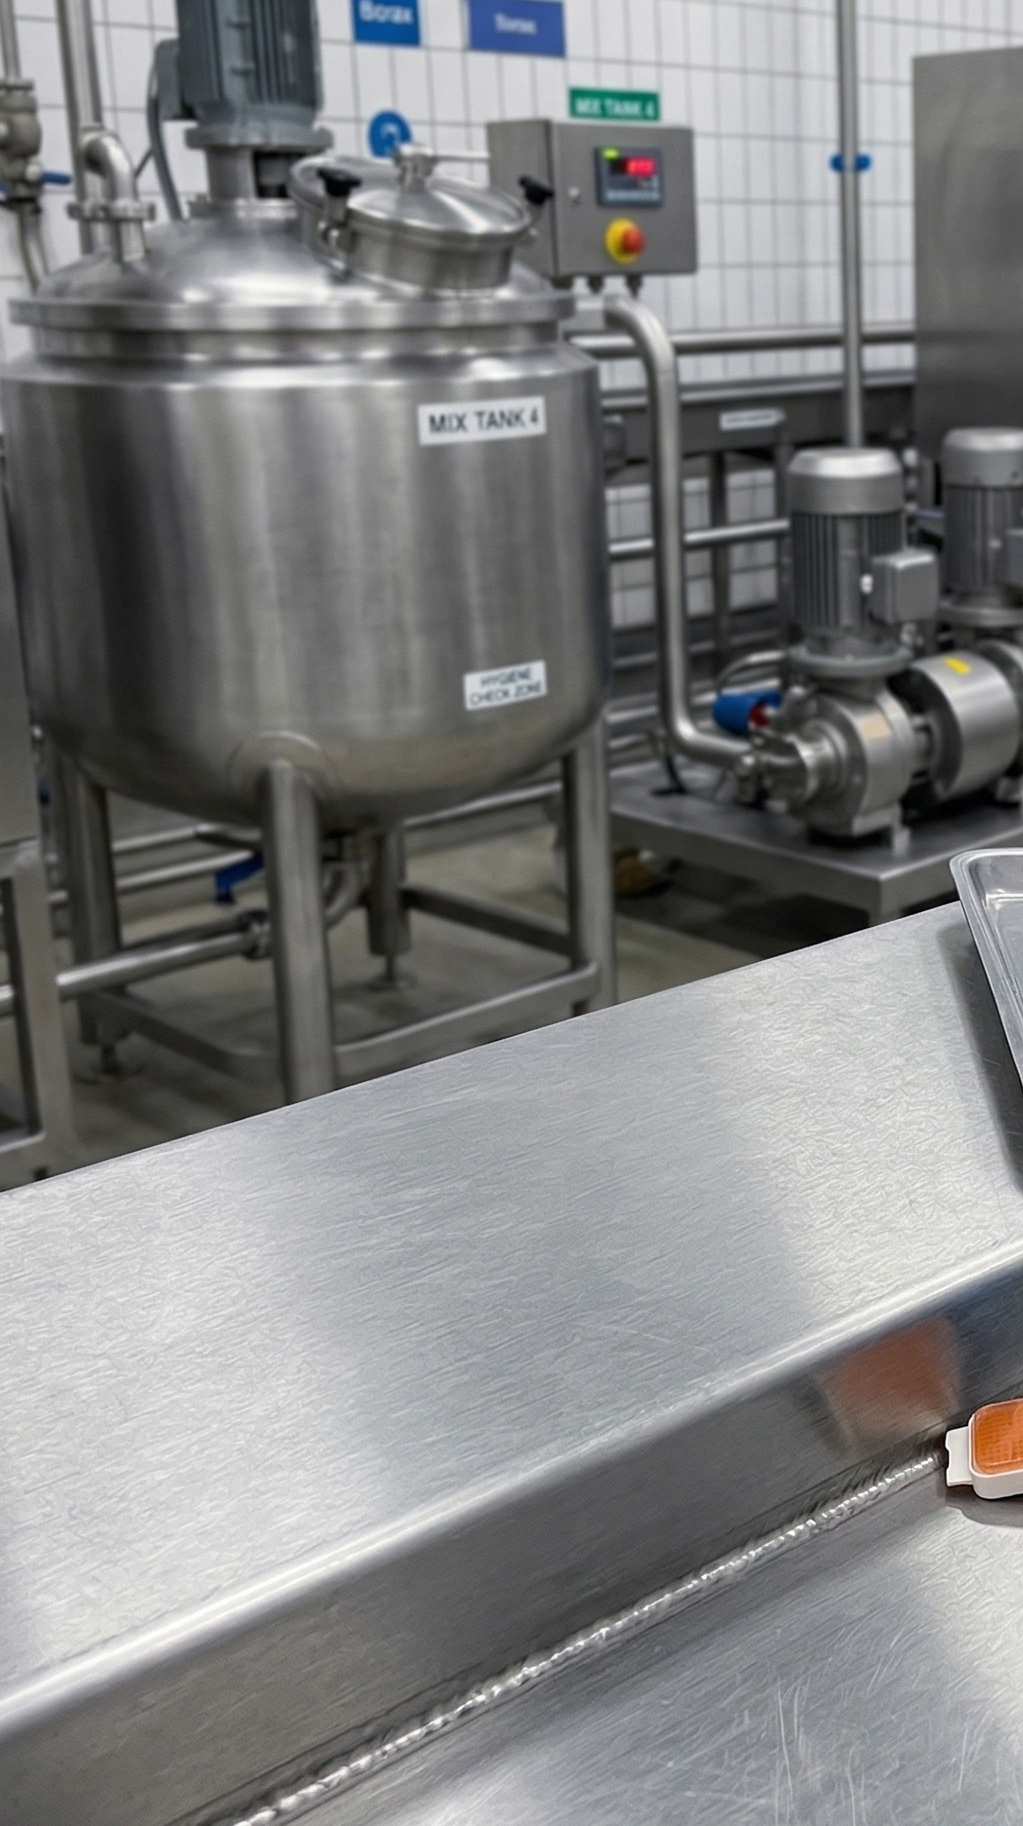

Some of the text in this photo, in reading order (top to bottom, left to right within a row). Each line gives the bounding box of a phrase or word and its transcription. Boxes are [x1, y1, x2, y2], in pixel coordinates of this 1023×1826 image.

[429, 407, 539, 433] MIX TANK 4
[480, 667, 532, 689] HYGIENE
[469, 688, 509, 706] CHECK
